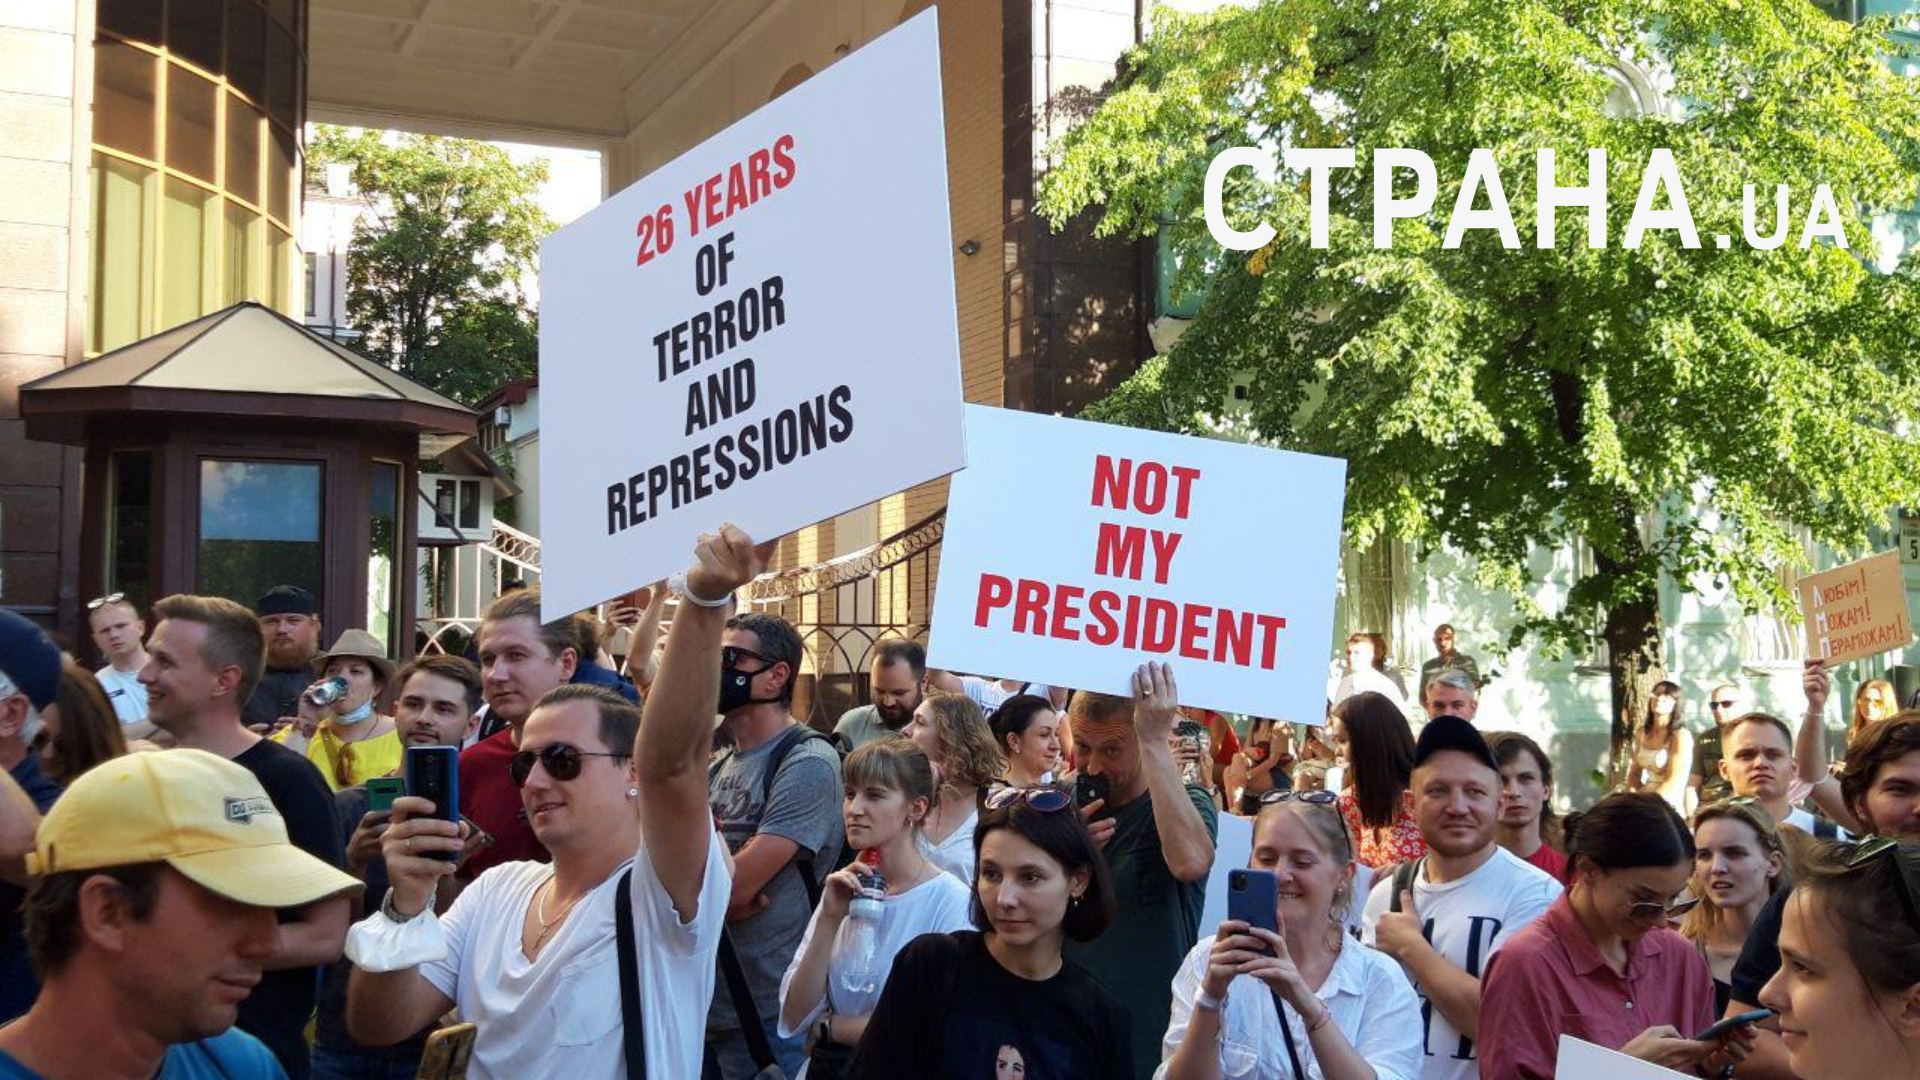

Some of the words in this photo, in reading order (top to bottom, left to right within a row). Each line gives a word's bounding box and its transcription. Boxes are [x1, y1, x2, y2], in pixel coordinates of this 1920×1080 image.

[636, 204, 675, 266] 26
[684, 134, 797, 237] YEARS
[695, 231, 735, 296] OF
[653, 275, 786, 382] TERROR
[685, 358, 756, 437] AND
[607, 384, 854, 535] REPRESSIONS
[1091, 455, 1201, 519] NOT
[1094, 523, 1182, 584] MY
[973, 573, 1287, 670] PRESIDENT
